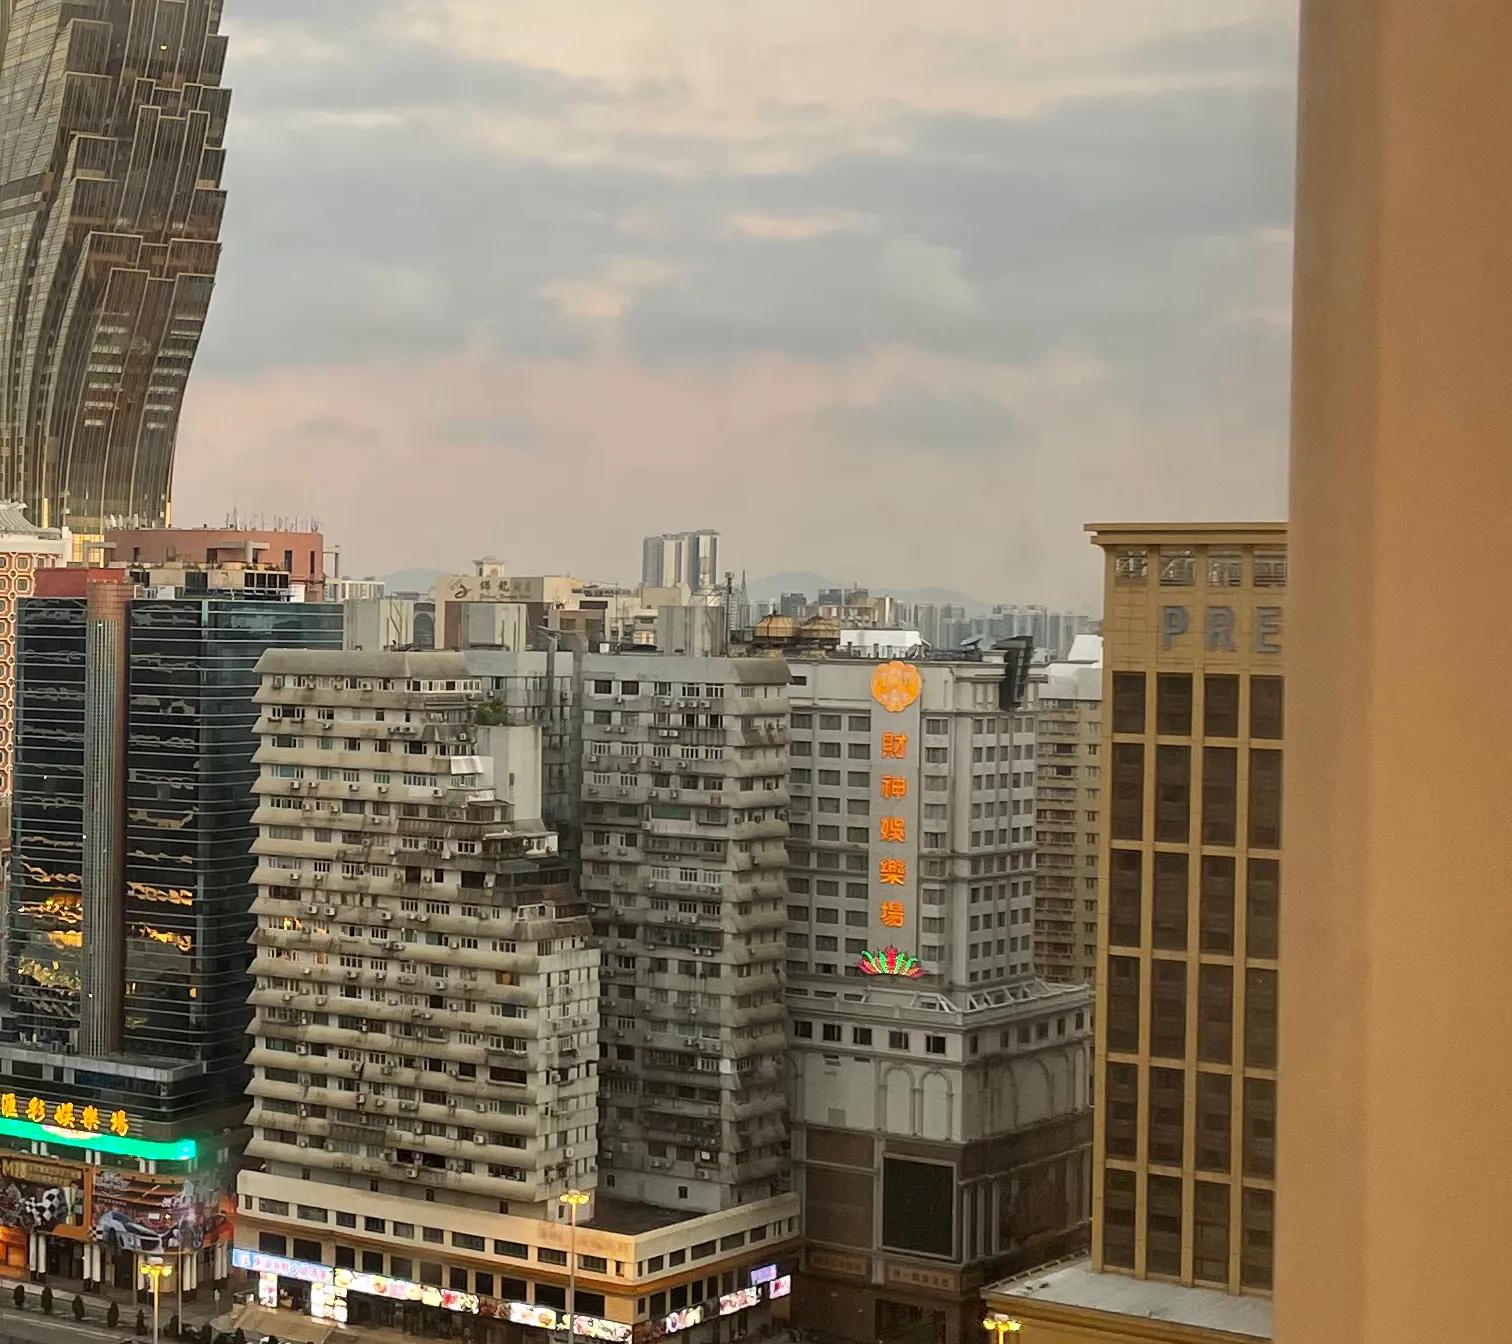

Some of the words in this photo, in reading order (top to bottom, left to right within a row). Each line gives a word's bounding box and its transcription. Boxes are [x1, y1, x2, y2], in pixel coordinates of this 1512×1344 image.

[879, 731, 908, 929] 財神娛樂場
